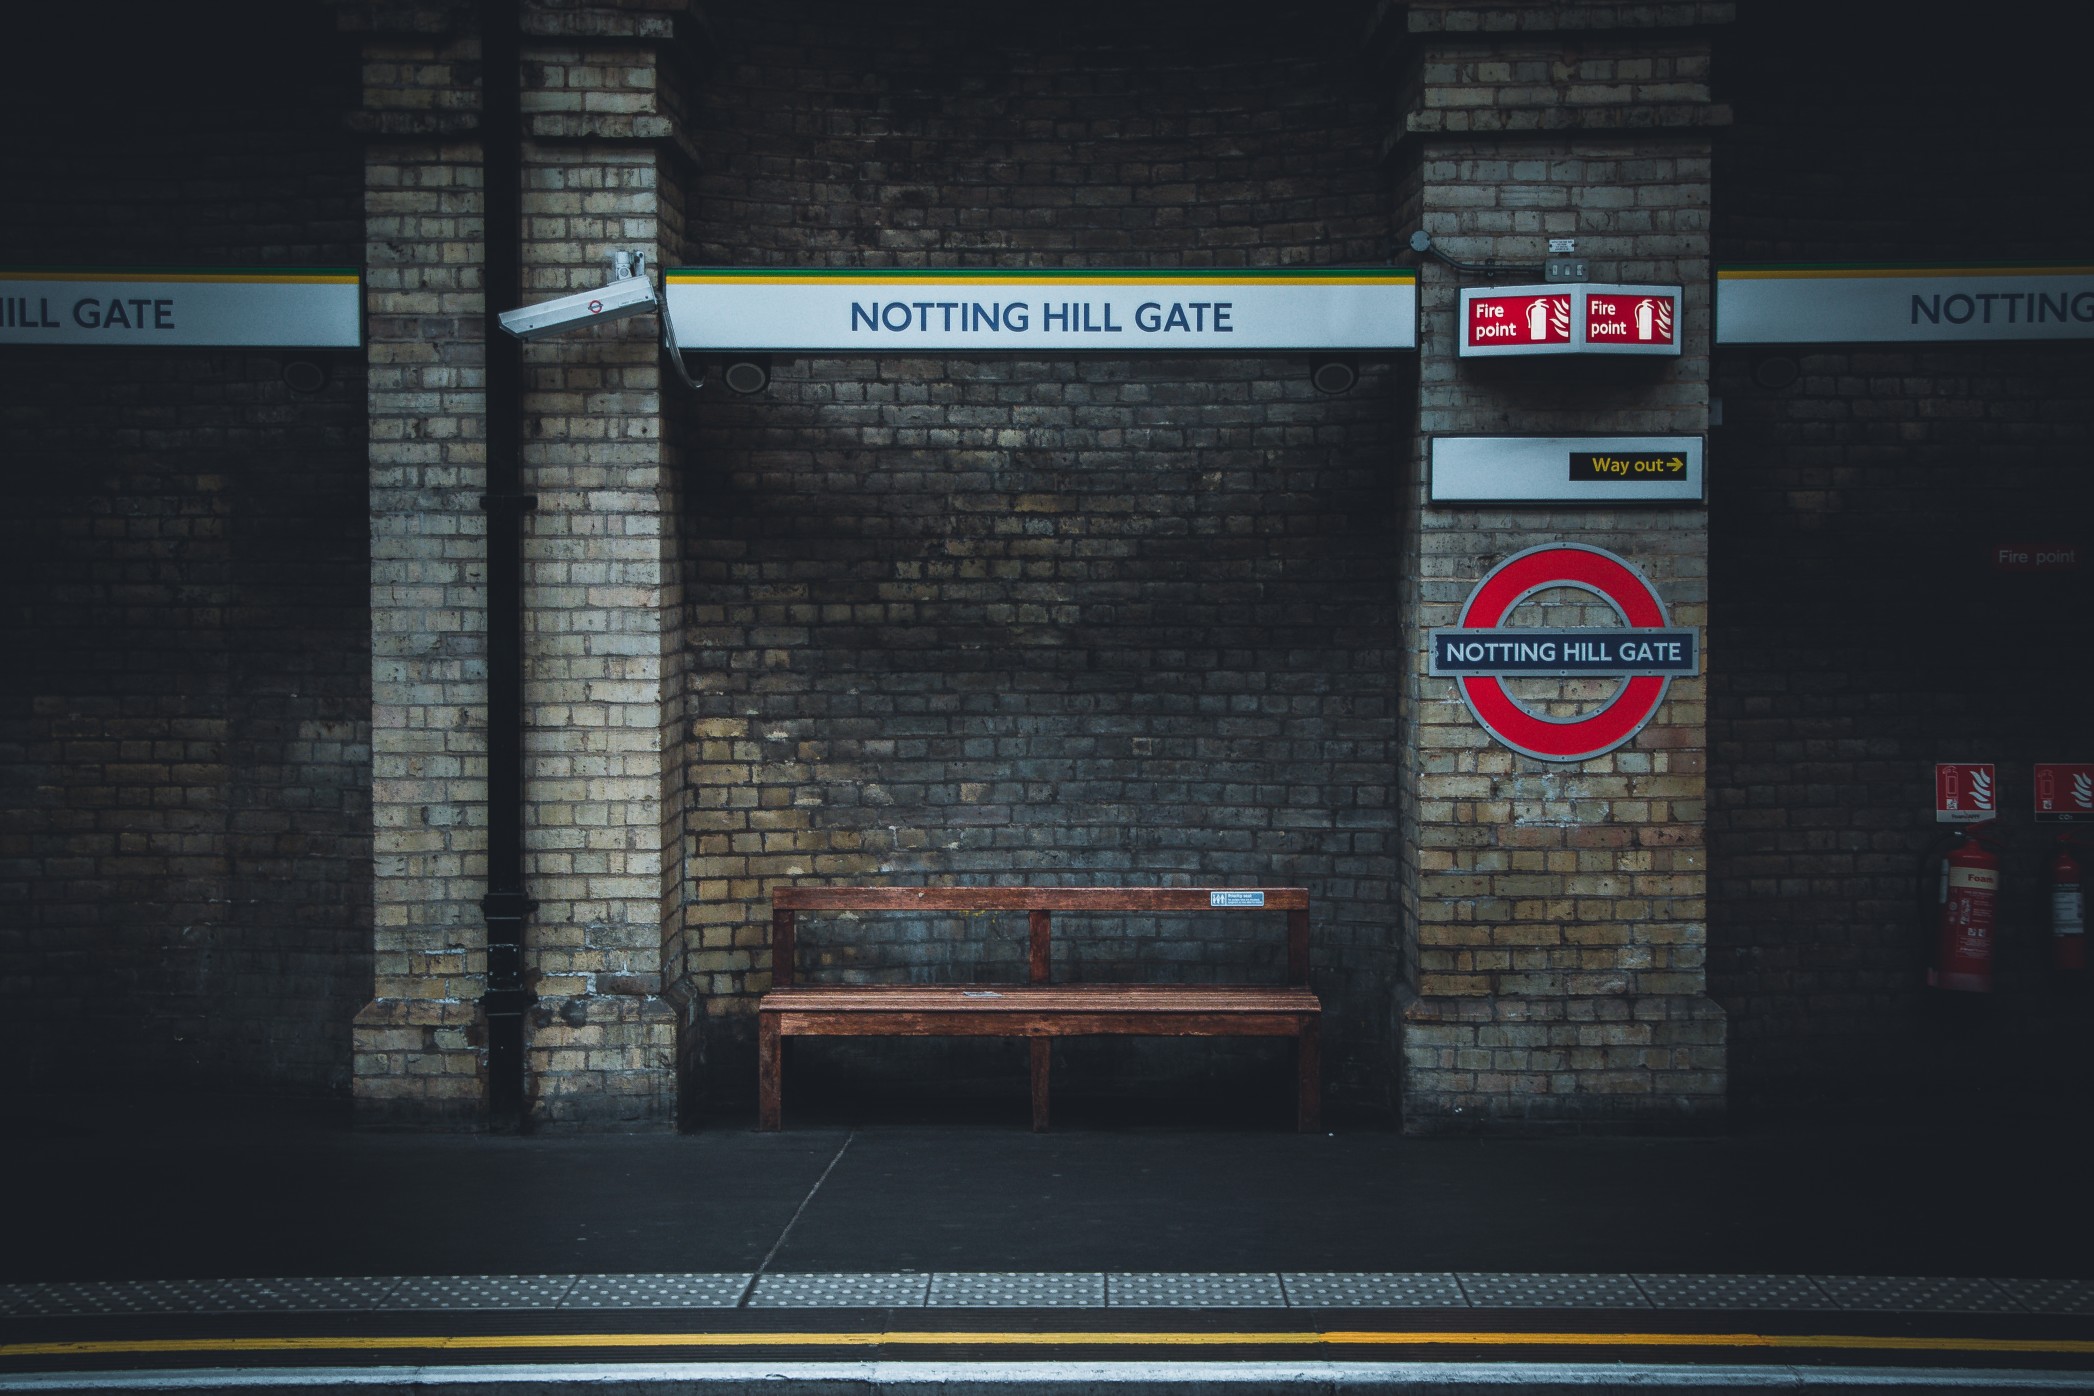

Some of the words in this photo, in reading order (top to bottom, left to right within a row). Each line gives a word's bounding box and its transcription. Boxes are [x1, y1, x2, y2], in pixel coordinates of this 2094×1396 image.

[0, 296, 60, 328] ILL
[72, 297, 175, 329] GATE
[852, 302, 1029, 333] NOTTING
[1043, 302, 1122, 333] HILL
[1135, 302, 1234, 333] GATE
[1476, 303, 1504, 318] Fire
[1591, 300, 1616, 316] Fire
[1911, 291, 2094, 325] NOTTING
[1476, 321, 1517, 340] point
[1591, 320, 1627, 338] point
[1592, 457, 1629, 476] Way
[1634, 458, 1664, 472] out
[1999, 549, 2029, 563] Fire
[2036, 549, 2075, 566] point
[1446, 642, 1556, 662] NOTTING
[1563, 642, 1612, 662] HILL
[1619, 642, 1682, 662] GATE
[1967, 874, 1994, 884] Foam
